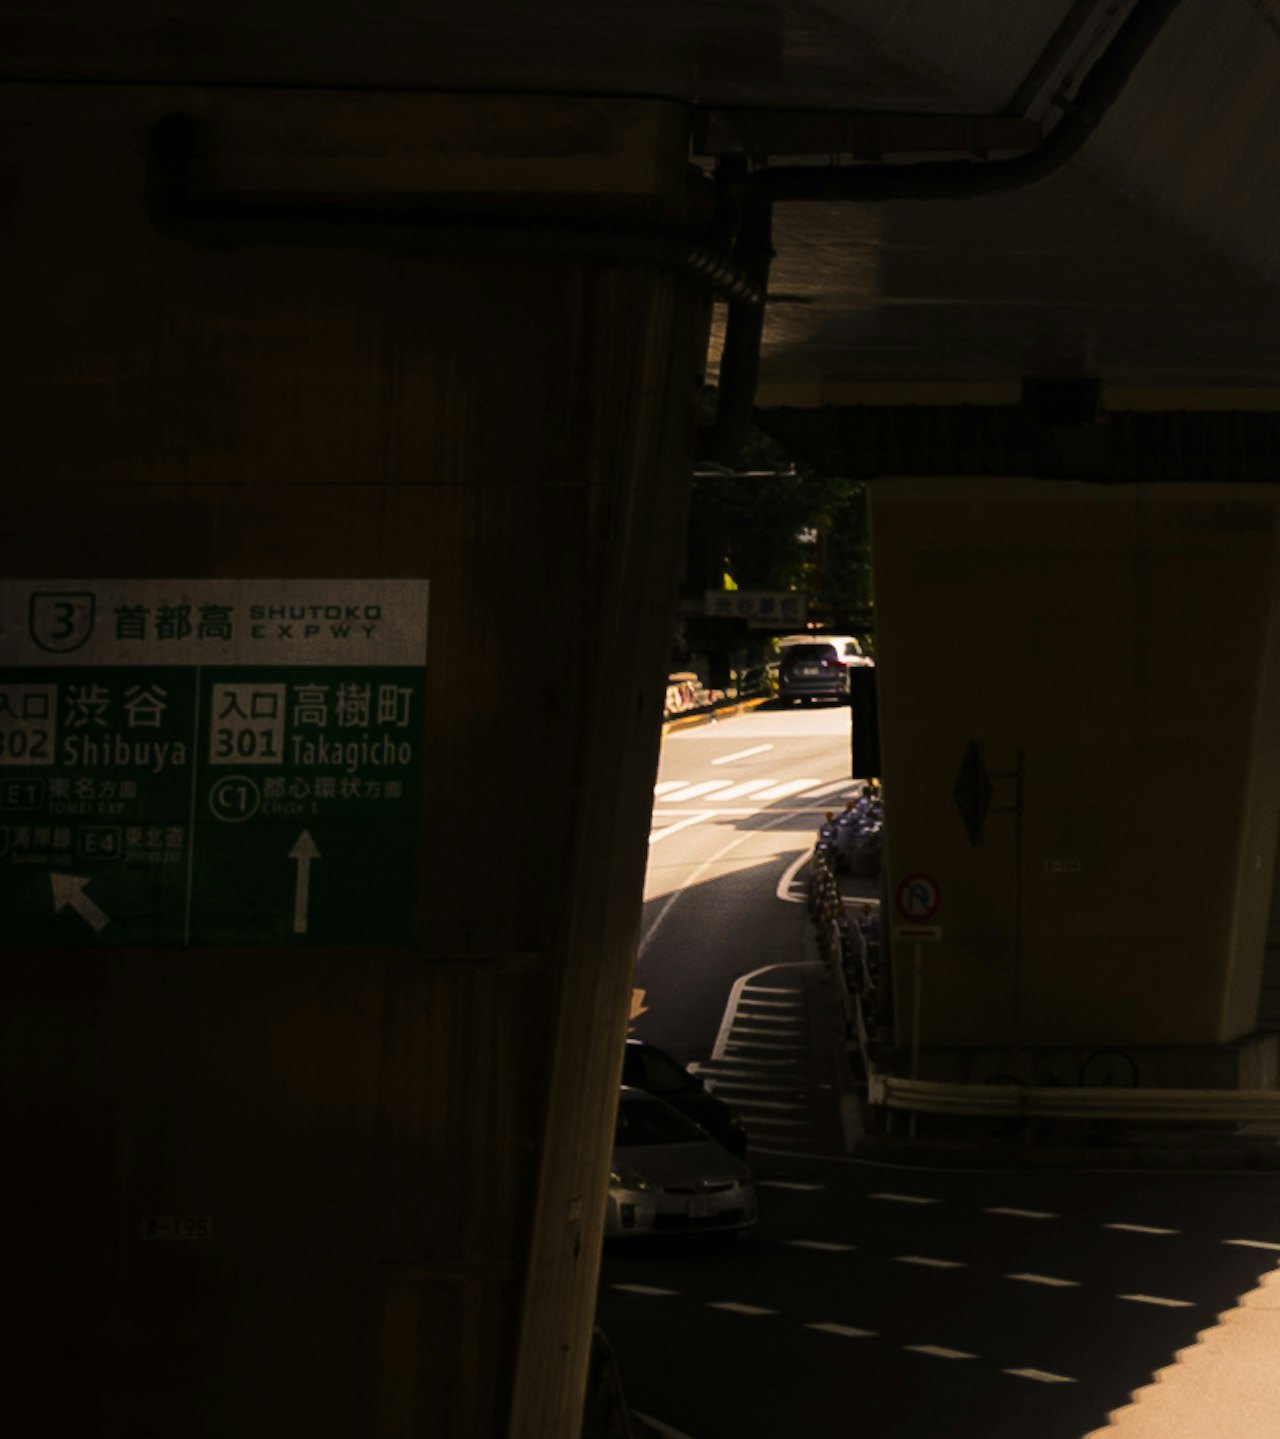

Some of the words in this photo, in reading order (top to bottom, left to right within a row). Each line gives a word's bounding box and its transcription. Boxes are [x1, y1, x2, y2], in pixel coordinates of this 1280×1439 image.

[53, 603, 74, 639] 3
[114, 603, 235, 641] 首都高
[251, 605, 381, 620] SHUTOKO
[64, 683, 168, 727] 渋谷
[219, 692, 279, 720] 入口
[293, 681, 414, 728] 高樹町
[0, 729, 47, 758] 02
[63, 732, 187, 774] Shibuya
[216, 728, 277, 758] 301
[292, 732, 412, 774] Takagicho
[6, 784, 36, 805] E1
[213, 784, 248, 812] C1
[262, 775, 404, 800] 都心環状方面
[83, 832, 114, 854] E4
